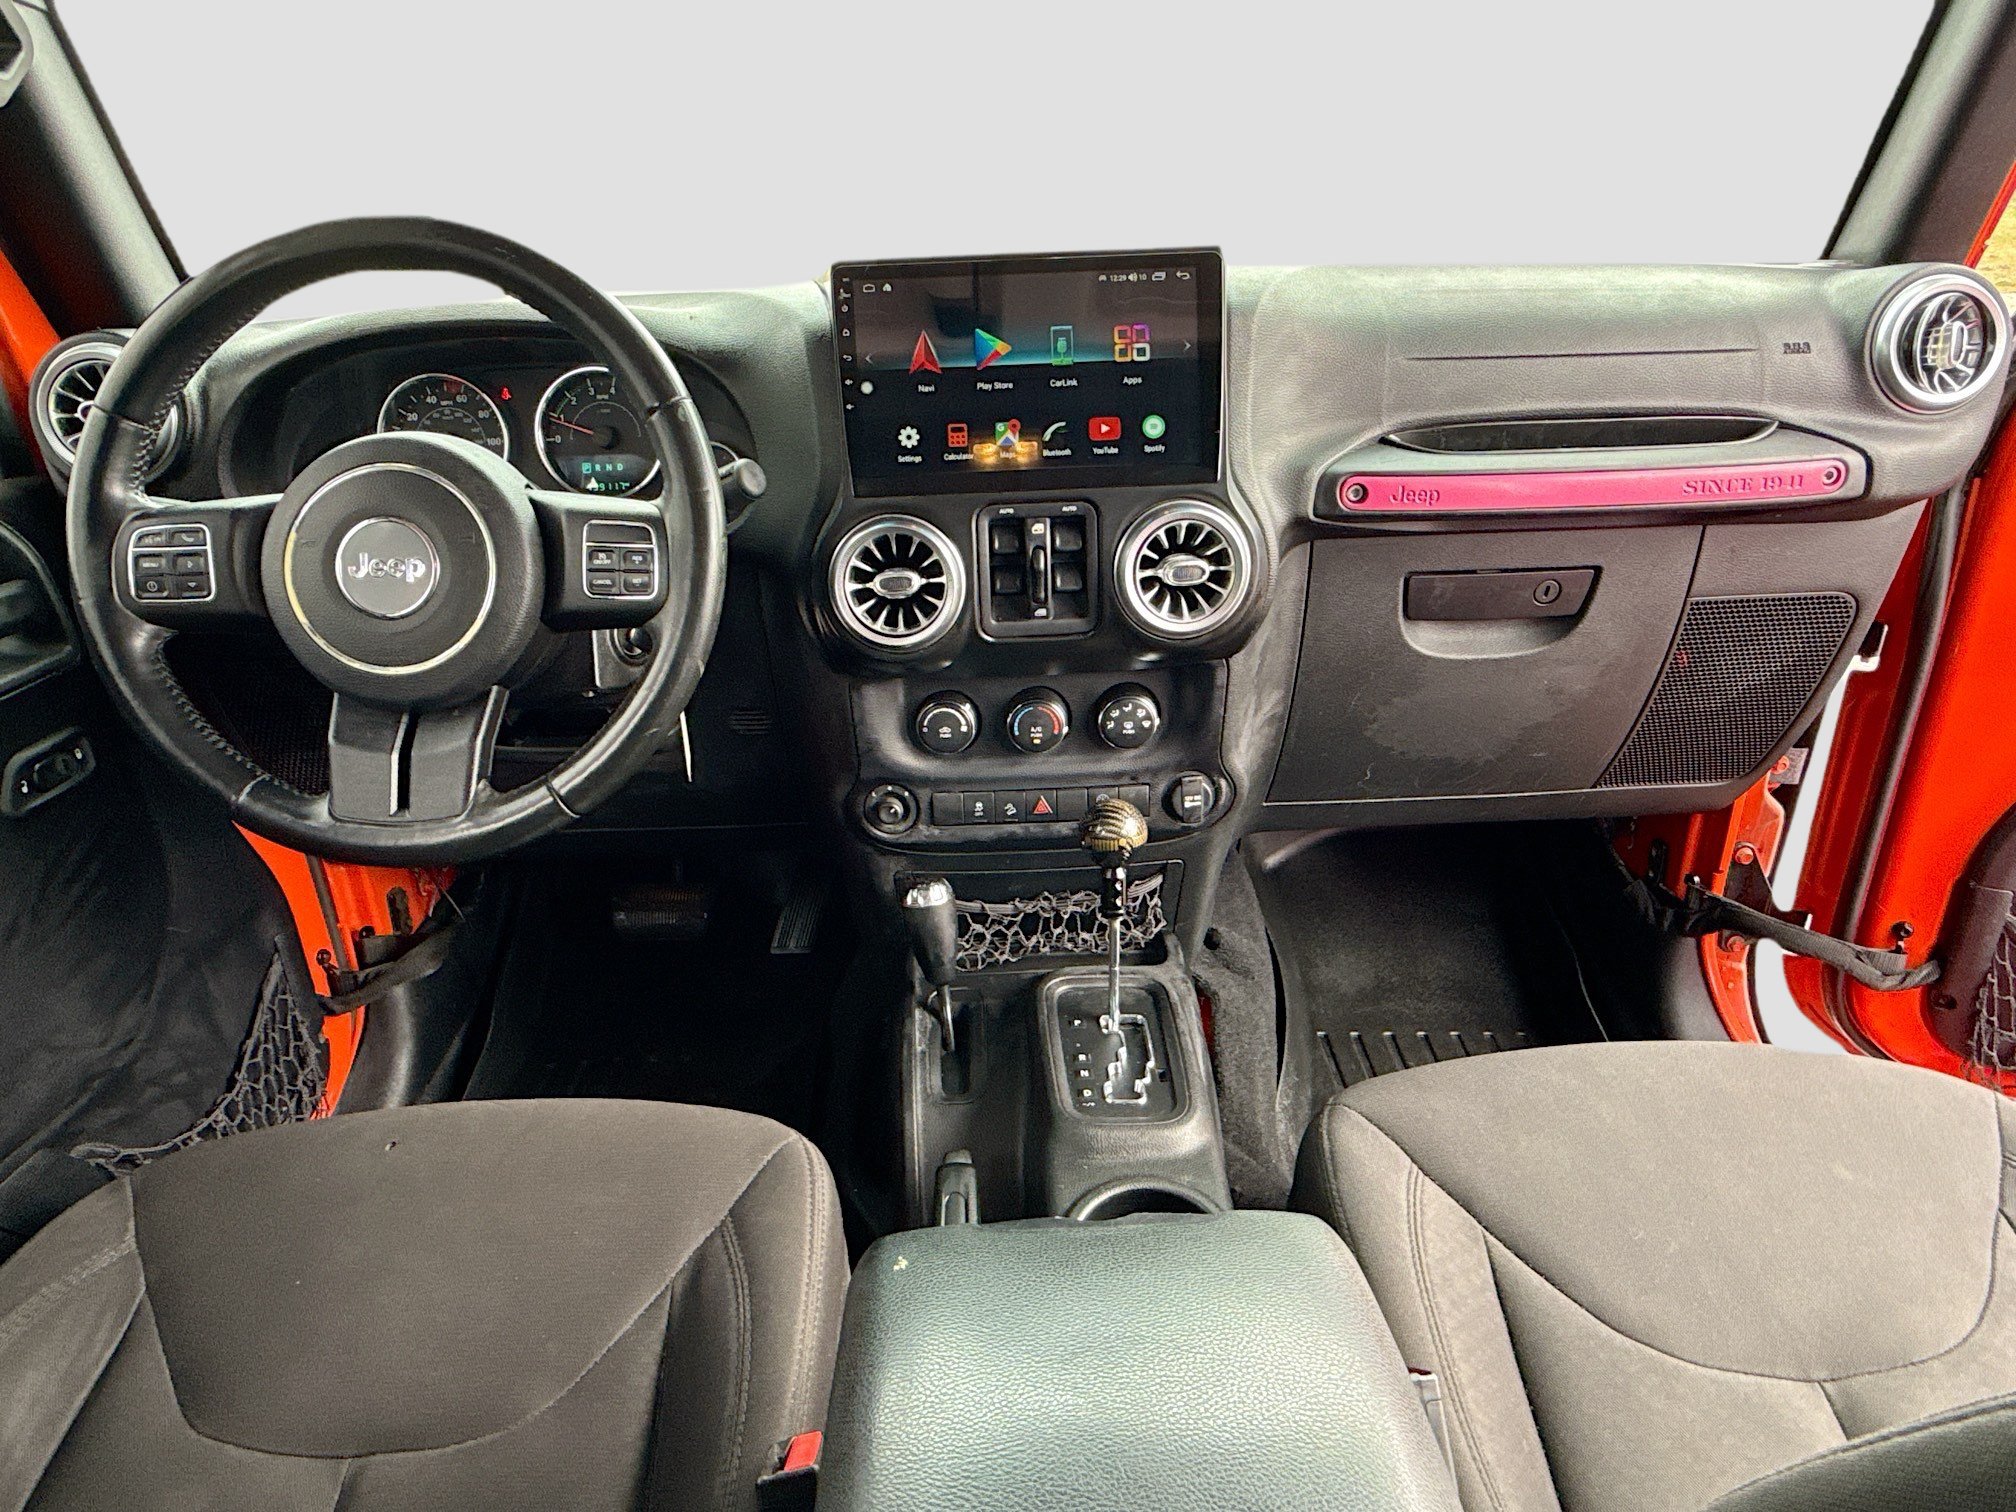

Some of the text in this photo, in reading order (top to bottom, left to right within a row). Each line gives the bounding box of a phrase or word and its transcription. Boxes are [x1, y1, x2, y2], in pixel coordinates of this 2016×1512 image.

[1049, 378, 1078, 387] CarLink
[1123, 376, 1142, 386] Apps
[918, 384, 935, 393] Navi
[976, 381, 1014, 392] Play Store
[425, 395, 438, 404] 40
[456, 394, 468, 403] 60
[406, 412, 419, 421] 20
[478, 409, 490, 419] 80
[487, 438, 501, 446] 100
[1042, 448, 1072, 457] Bluetooth
[1092, 446, 1119, 455] YouTube
[1143, 444, 1166, 454] Spotify
[897, 454, 923, 463] Settings
[1682, 478, 1753, 496] SINCE
[1388, 485, 1440, 506] Jeep
[347, 552, 426, 583] Jeep
[1080, 1069, 1090, 1078] N
[1083, 1088, 1092, 1097] D
